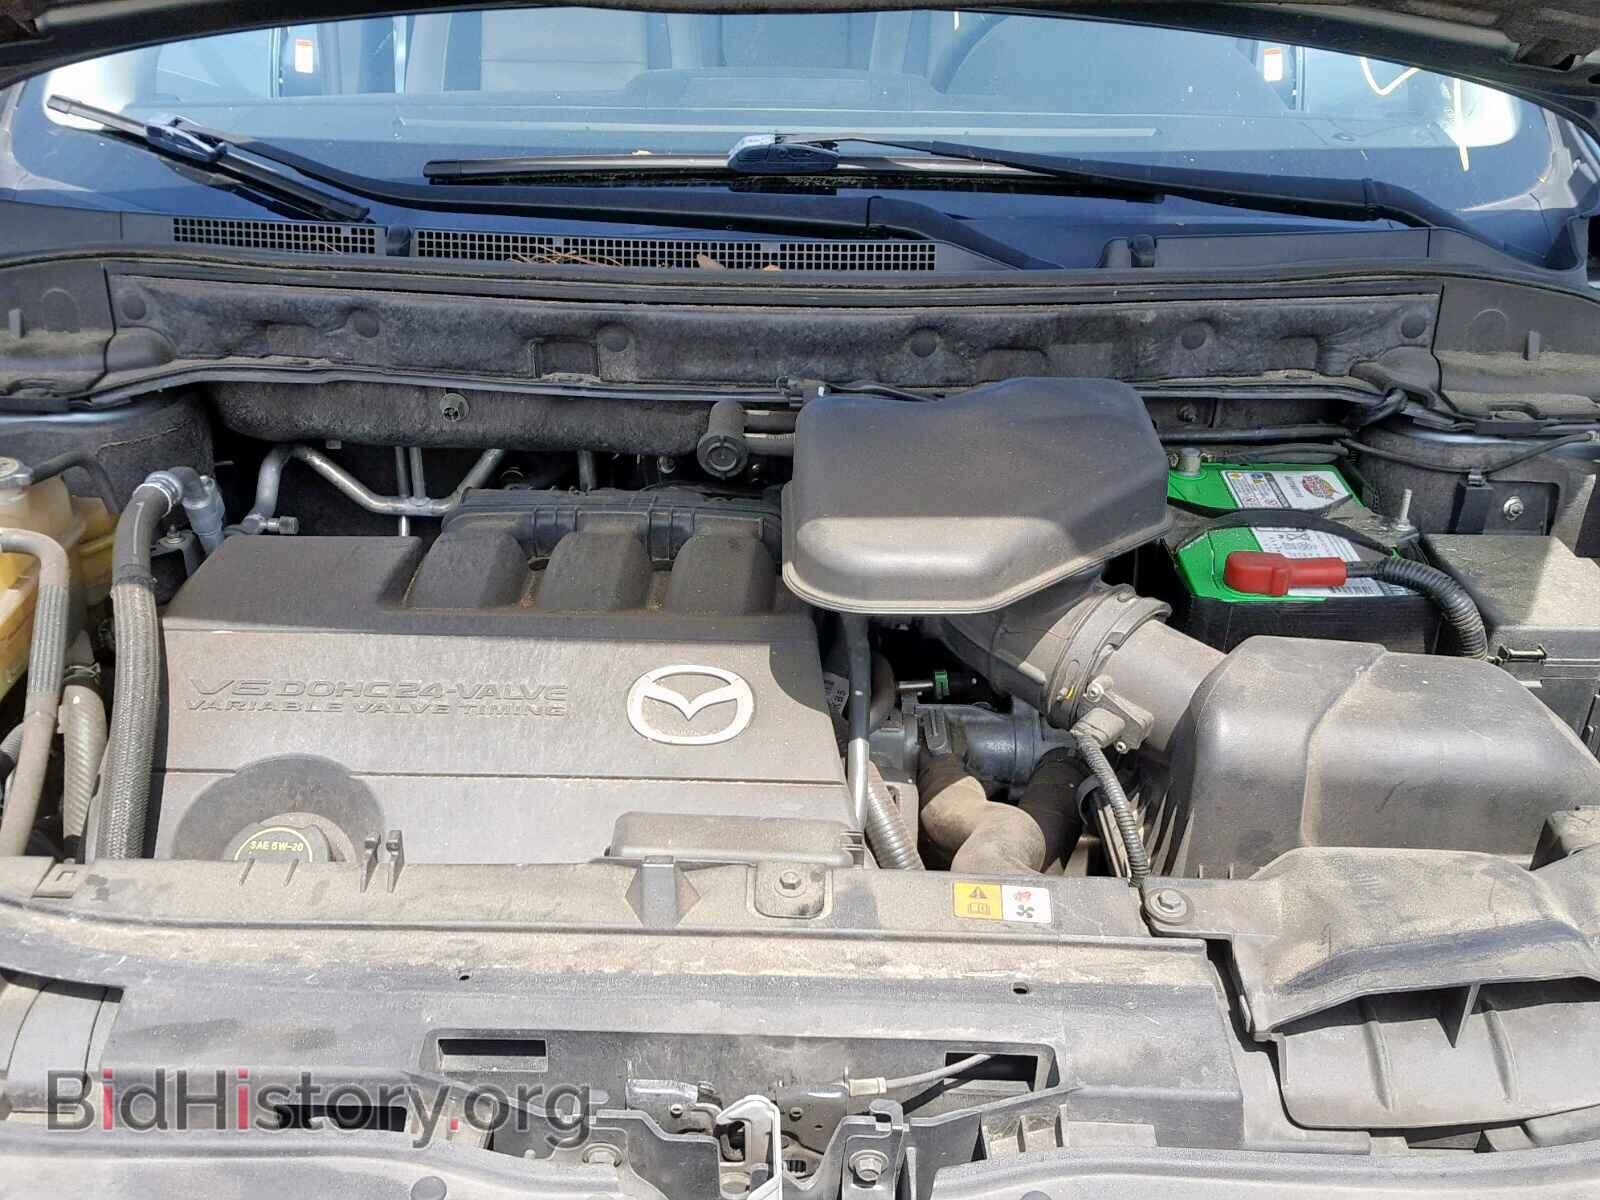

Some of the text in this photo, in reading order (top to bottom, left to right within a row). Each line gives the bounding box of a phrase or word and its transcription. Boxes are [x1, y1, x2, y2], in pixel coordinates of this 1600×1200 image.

[188, 679, 272, 696] V6
[187, 700, 566, 717] VARIABLE VALVE TIMING
[248, 840, 270, 851] SAE
